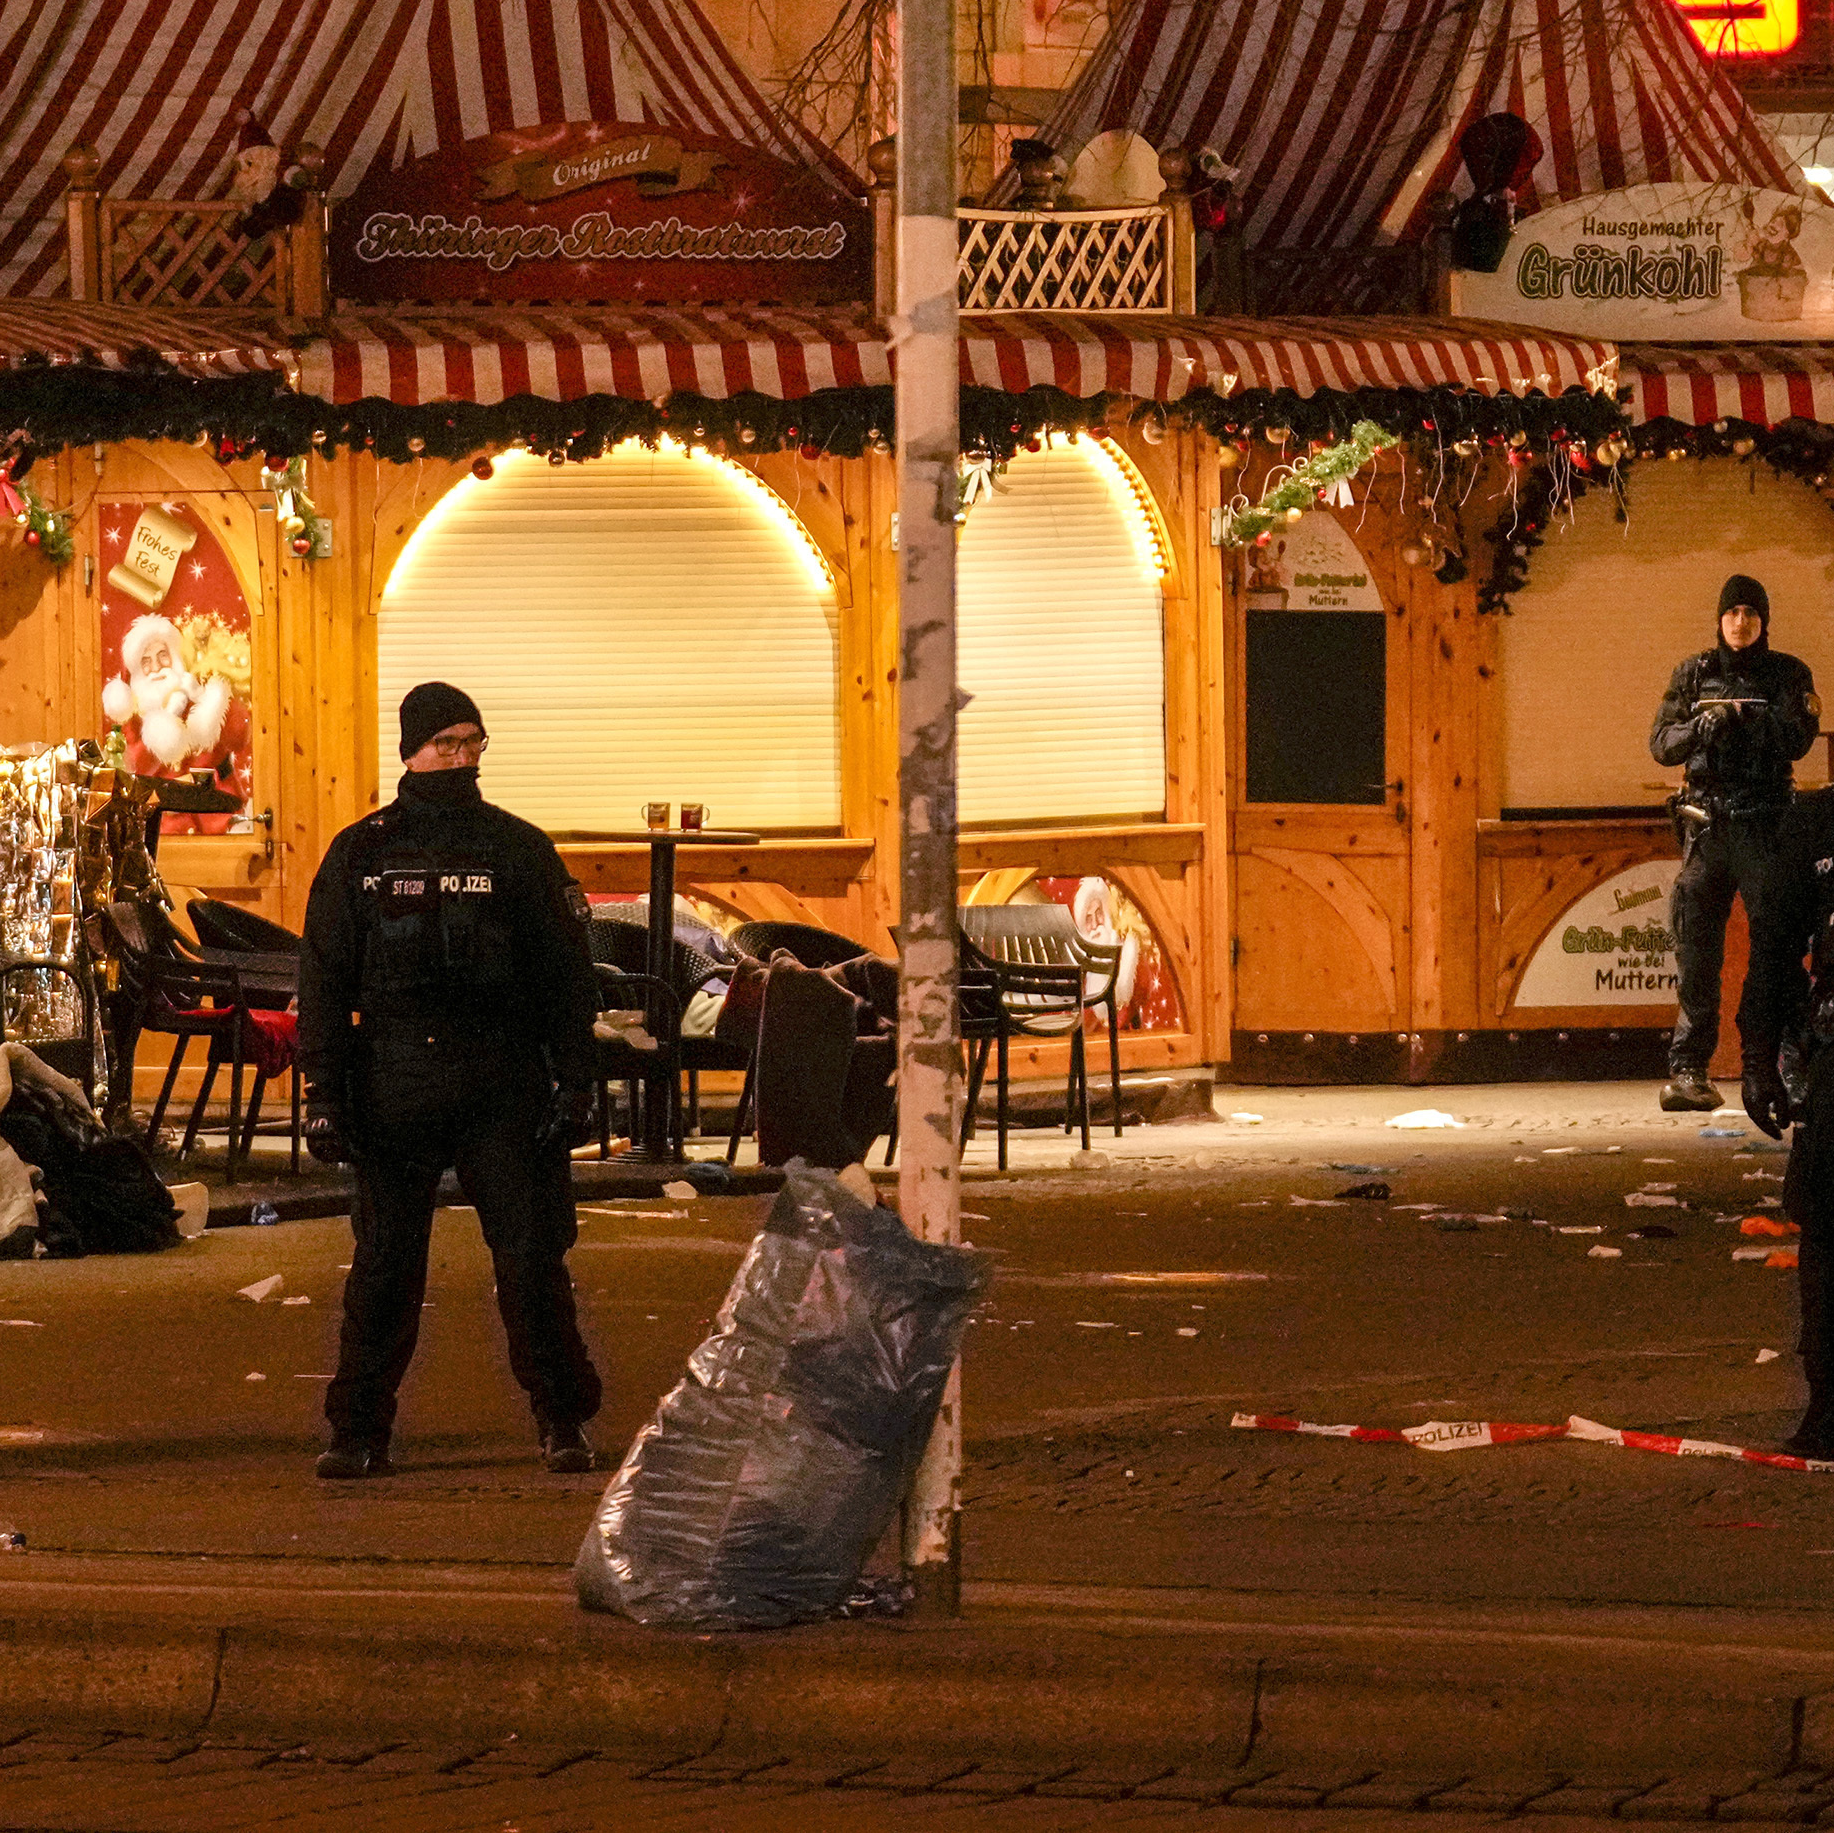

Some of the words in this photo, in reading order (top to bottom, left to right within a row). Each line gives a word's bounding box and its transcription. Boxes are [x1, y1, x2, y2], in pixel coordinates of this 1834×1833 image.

[552, 142, 652, 187] Original
[357, 212, 563, 270] Thüringer
[560, 212, 847, 259] Rostbratwurst
[1582, 217, 1724, 243] Hausgemachter
[1517, 243, 1723, 302] Grünkohl
[138, 526, 177, 561] Frohes
[136, 551, 160, 576] Fest
[1618, 954, 1640, 968] wie
[1646, 952, 1665, 968] bei
[1596, 969, 1679, 991] Muttern
